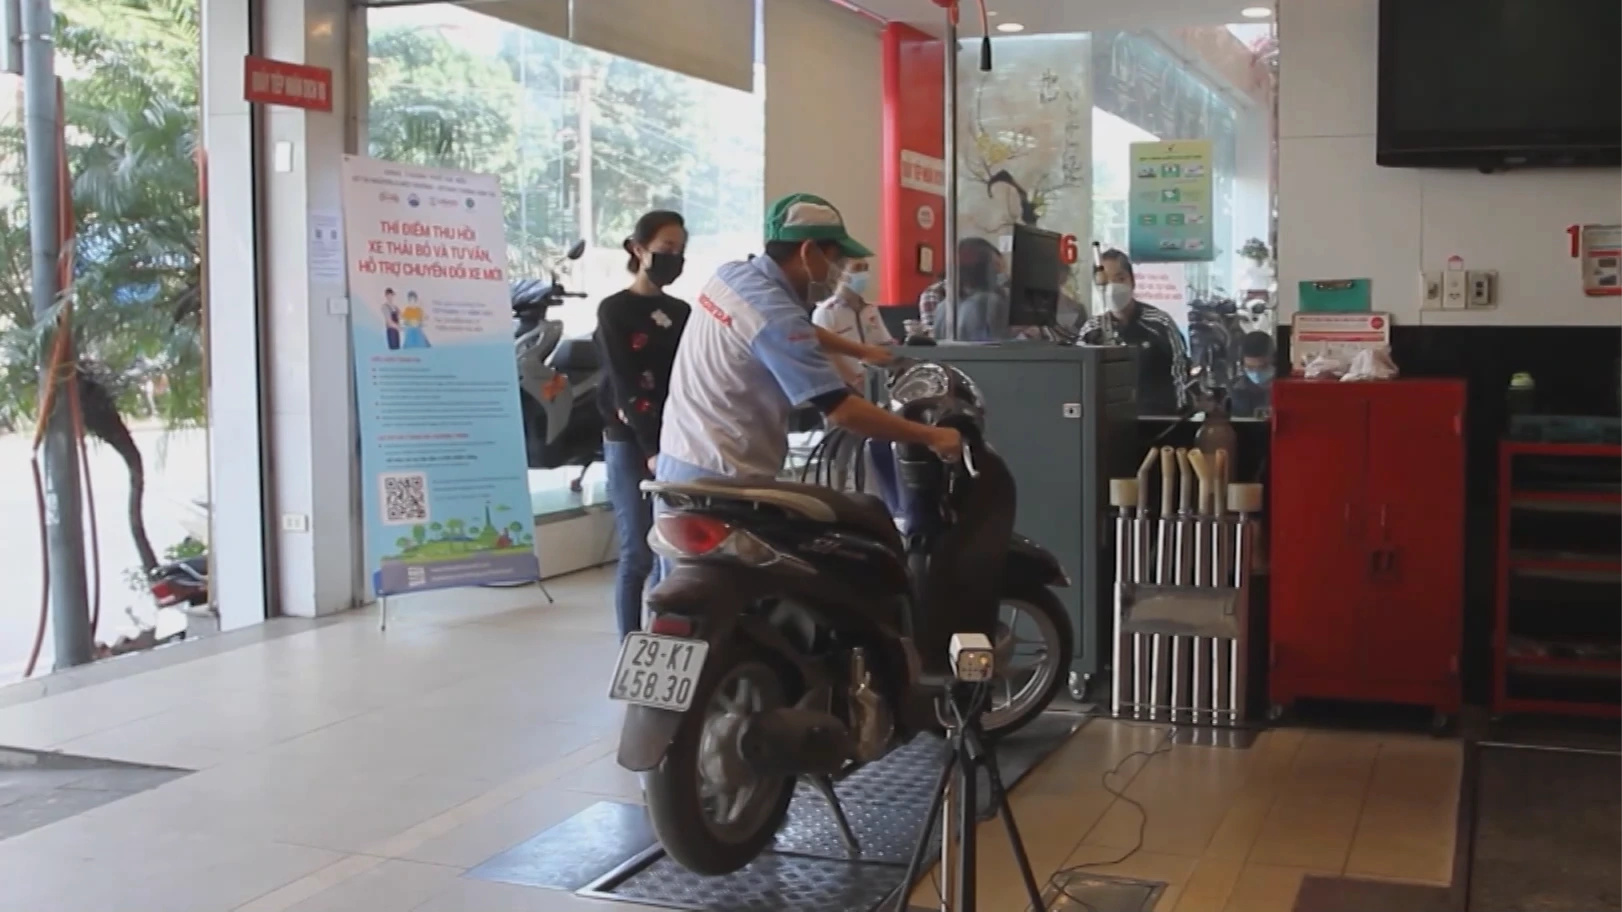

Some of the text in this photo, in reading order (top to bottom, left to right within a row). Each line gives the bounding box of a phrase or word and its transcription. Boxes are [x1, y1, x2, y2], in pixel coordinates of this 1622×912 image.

[380, 220, 399, 234] THÍ
[432, 225, 456, 240] THU
[1566, 225, 1580, 258] 1
[368, 240, 385, 254] XE
[386, 239, 412, 256] THẢI
[415, 240, 432, 257] BỎ
[433, 242, 450, 259] VÀ
[1059, 233, 1078, 264] 6
[378, 261, 401, 277] TRỢ
[468, 267, 482, 280] XE
[631, 638, 695, 672] 29-K1
